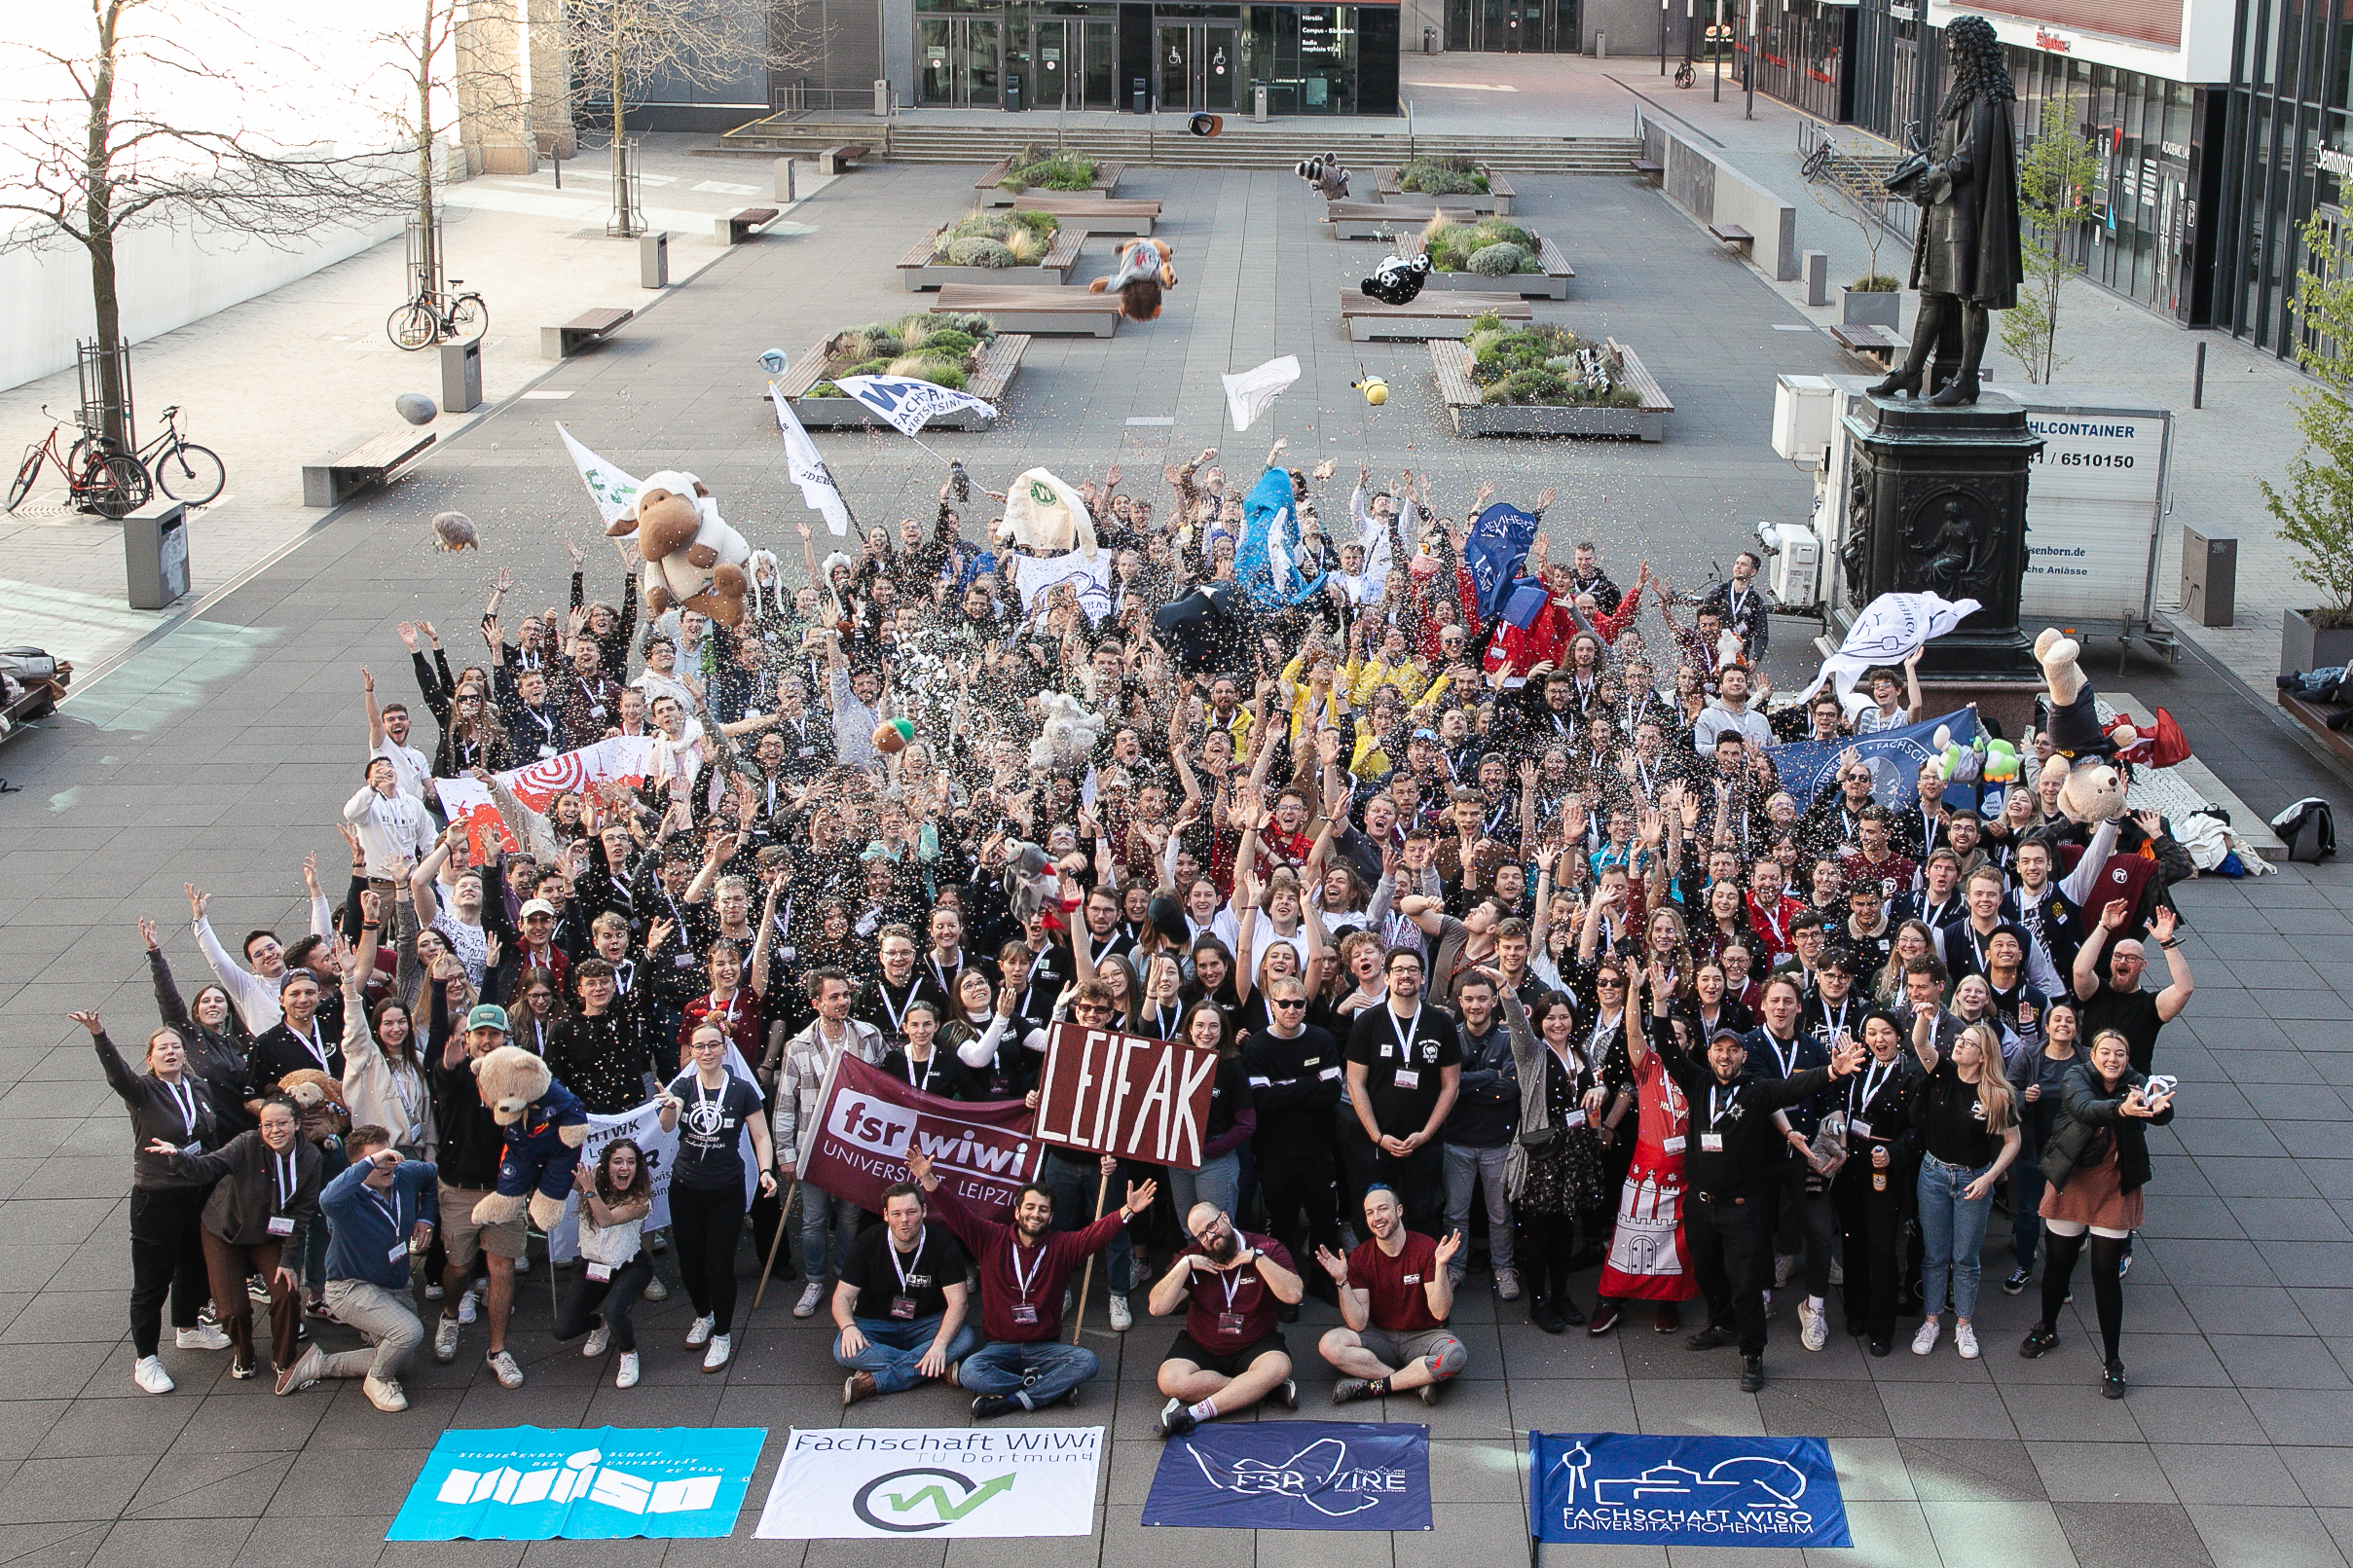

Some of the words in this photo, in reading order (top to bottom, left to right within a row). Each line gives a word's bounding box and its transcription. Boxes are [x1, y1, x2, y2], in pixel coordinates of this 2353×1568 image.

[2161, 140, 2183, 158] ACADEMIC
[2061, 453, 2135, 469] 6510150
[2046, 565, 2088, 576] Anlässe
[1876, 740, 1928, 766] FACHSCH
[1037, 1022, 1217, 1168] LEIFAK
[587, 1118, 640, 1144] HTWK
[843, 1101, 906, 1148] fsr
[919, 1129, 1028, 1179] wiwi
[824, 1140, 946, 1187] UNIVERSIT
[794, 1433, 995, 1451] Fachschaft
[1006, 1432, 1096, 1450] WiWi
[459, 1450, 567, 1459] STUDIERENDEN
[607, 1457, 699, 1467] UNIVERSITÄT
[915, 1452, 946, 1463] TU
[961, 1451, 1093, 1463] Dortmund
[1563, 1507, 1730, 1523] FACHSCHAFT
[1736, 1510, 1813, 1524] WISO
[1563, 1518, 1682, 1532] UNIVERSITÄT
[1686, 1519, 1814, 1535] HOHENHEIM
